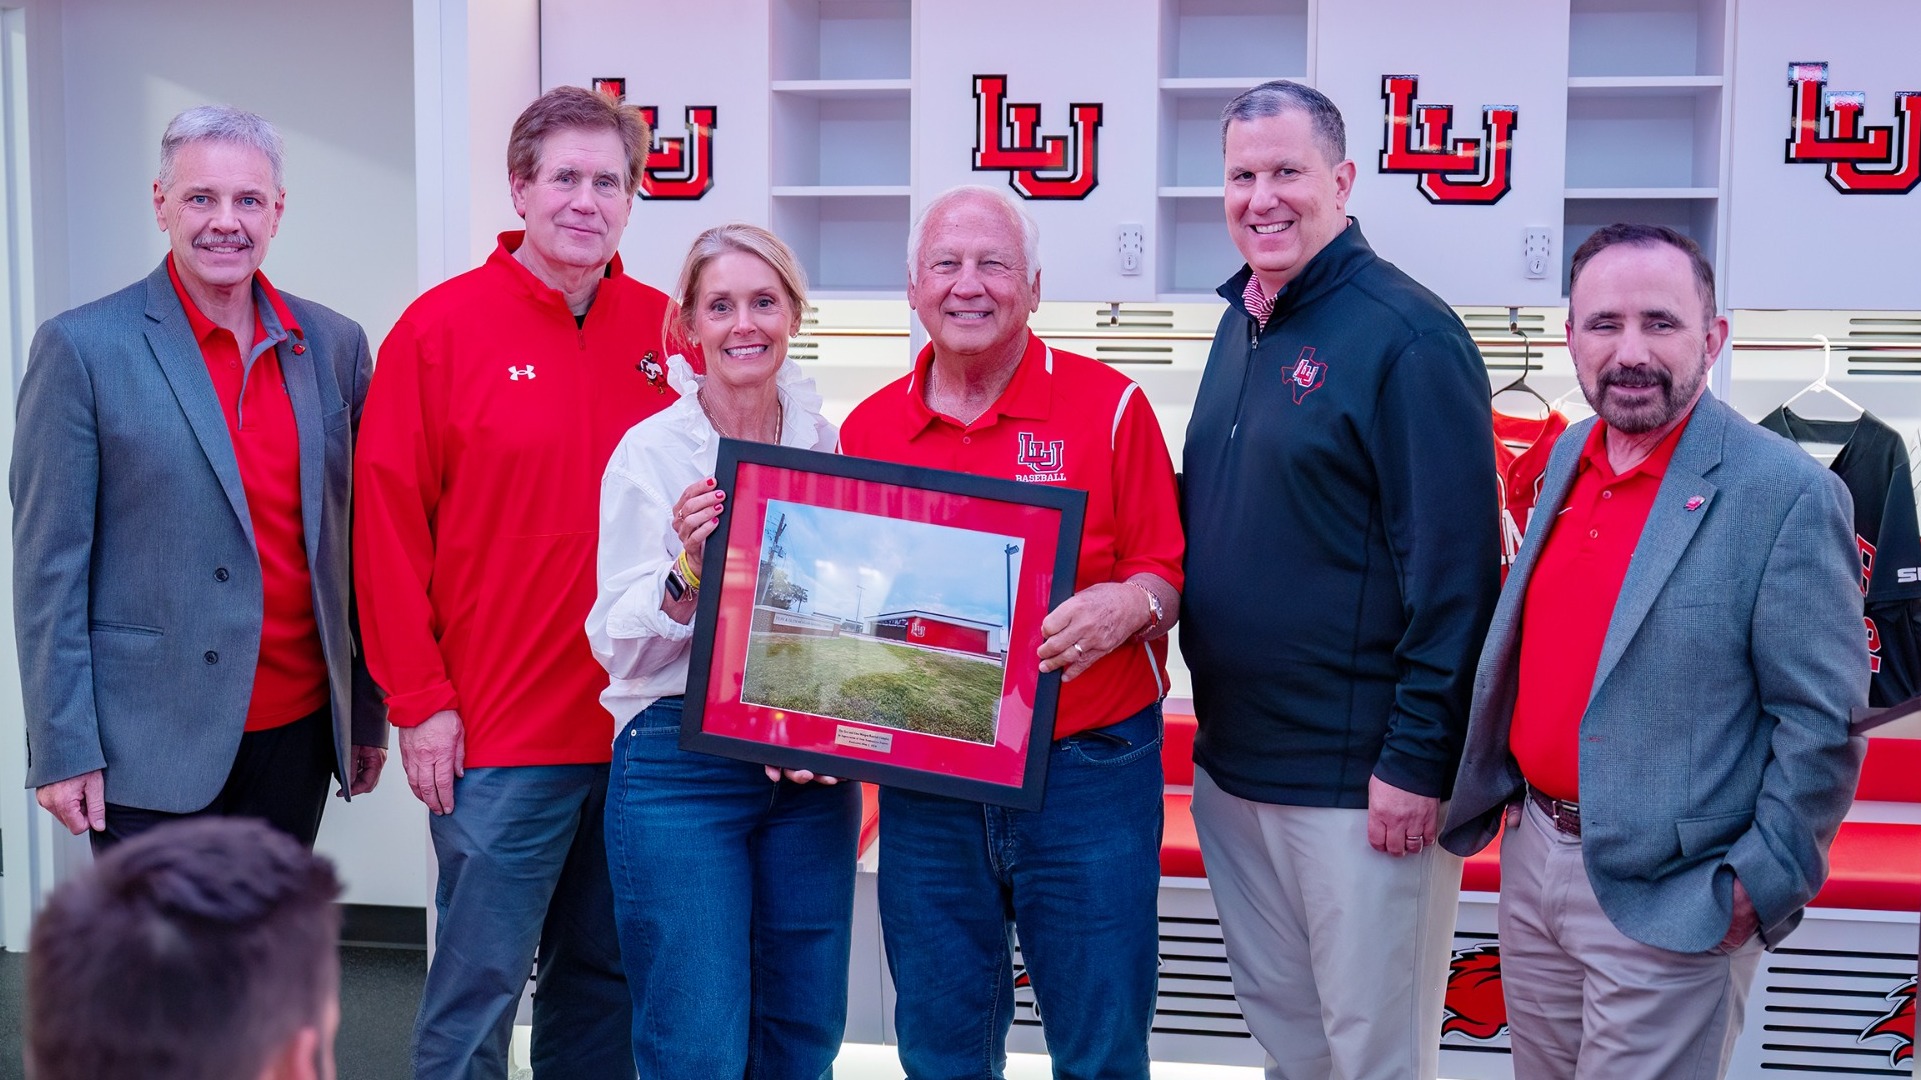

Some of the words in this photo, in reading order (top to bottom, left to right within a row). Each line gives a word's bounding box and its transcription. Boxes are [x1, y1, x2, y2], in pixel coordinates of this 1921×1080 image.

[972, 74, 1104, 201] LU
[1378, 74, 1519, 206] LU
[1784, 61, 1921, 195] LU
[1293, 358, 1319, 388] LU
[1015, 473, 1067, 483] BASEBALL
[1018, 432, 1064, 473] LU
